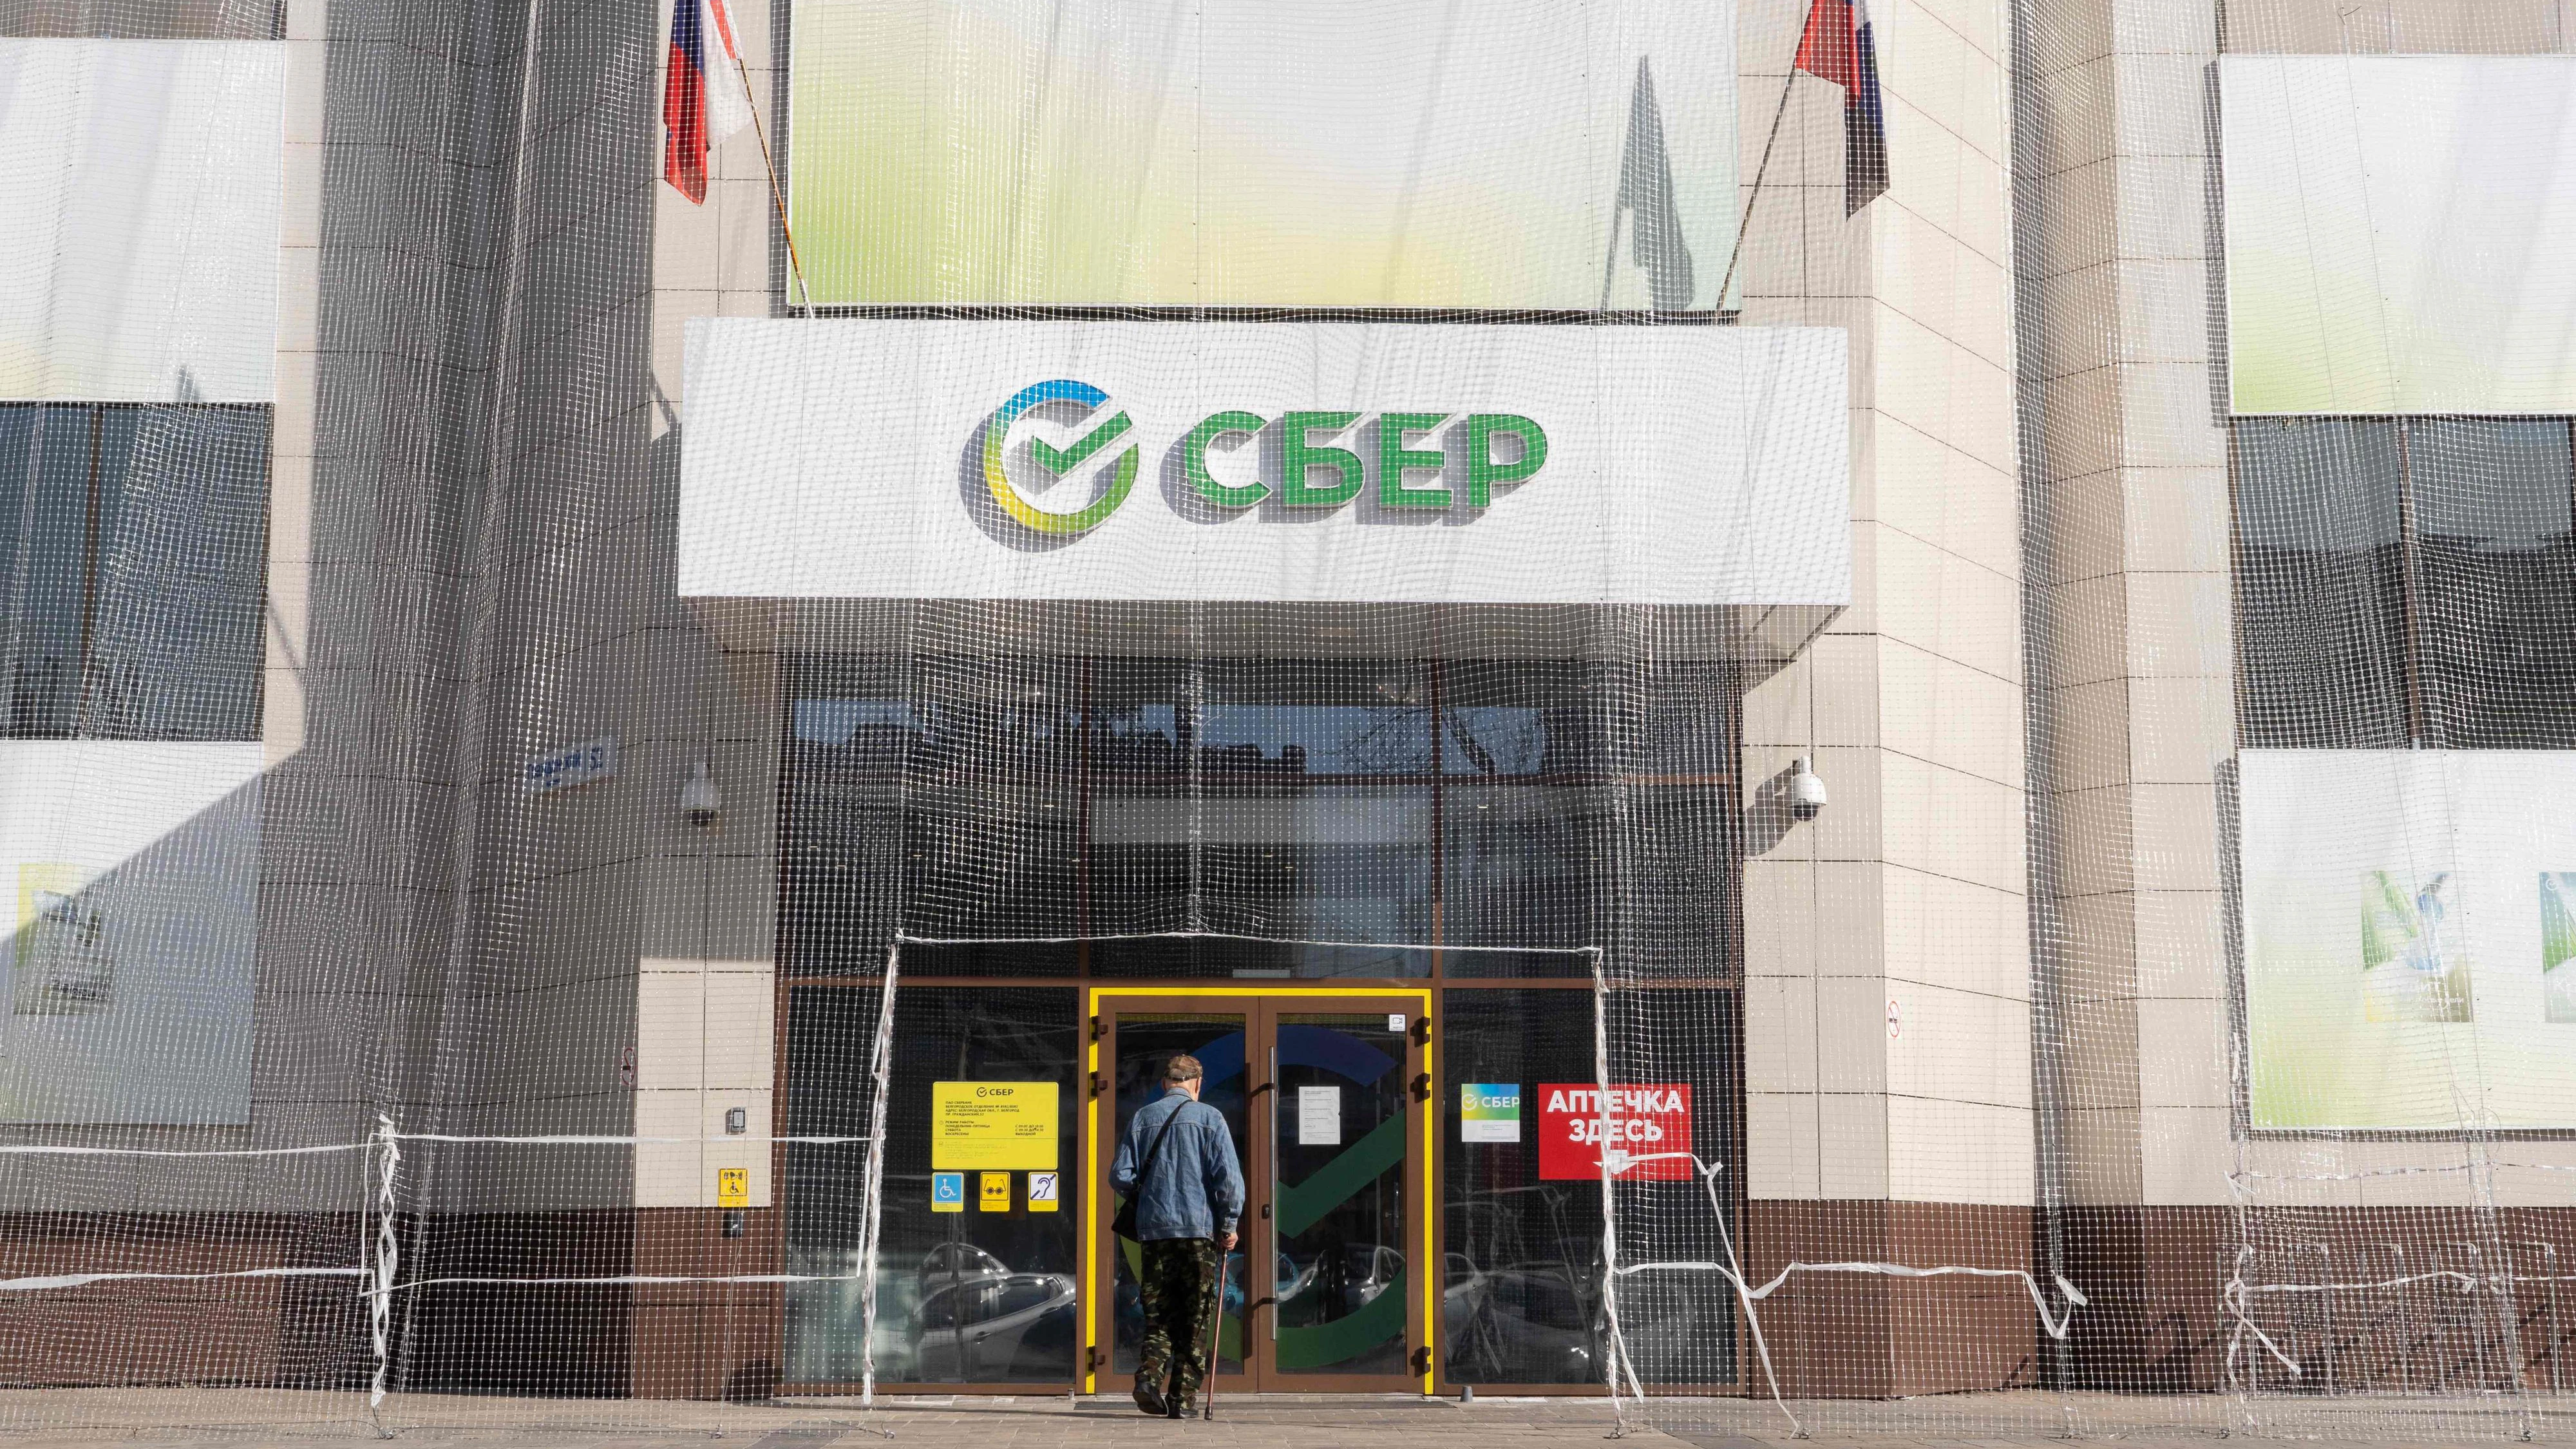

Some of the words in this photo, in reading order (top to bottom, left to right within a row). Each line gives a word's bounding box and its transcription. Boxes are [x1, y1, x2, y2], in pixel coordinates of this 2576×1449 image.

[1184, 410, 1549, 510] СБЕР
[1481, 1096, 1520, 1108] СБЕР
[1547, 1090, 1685, 1113] АПТЕЧКА
[1569, 1119, 1663, 1146] ЗДЕСЬ
